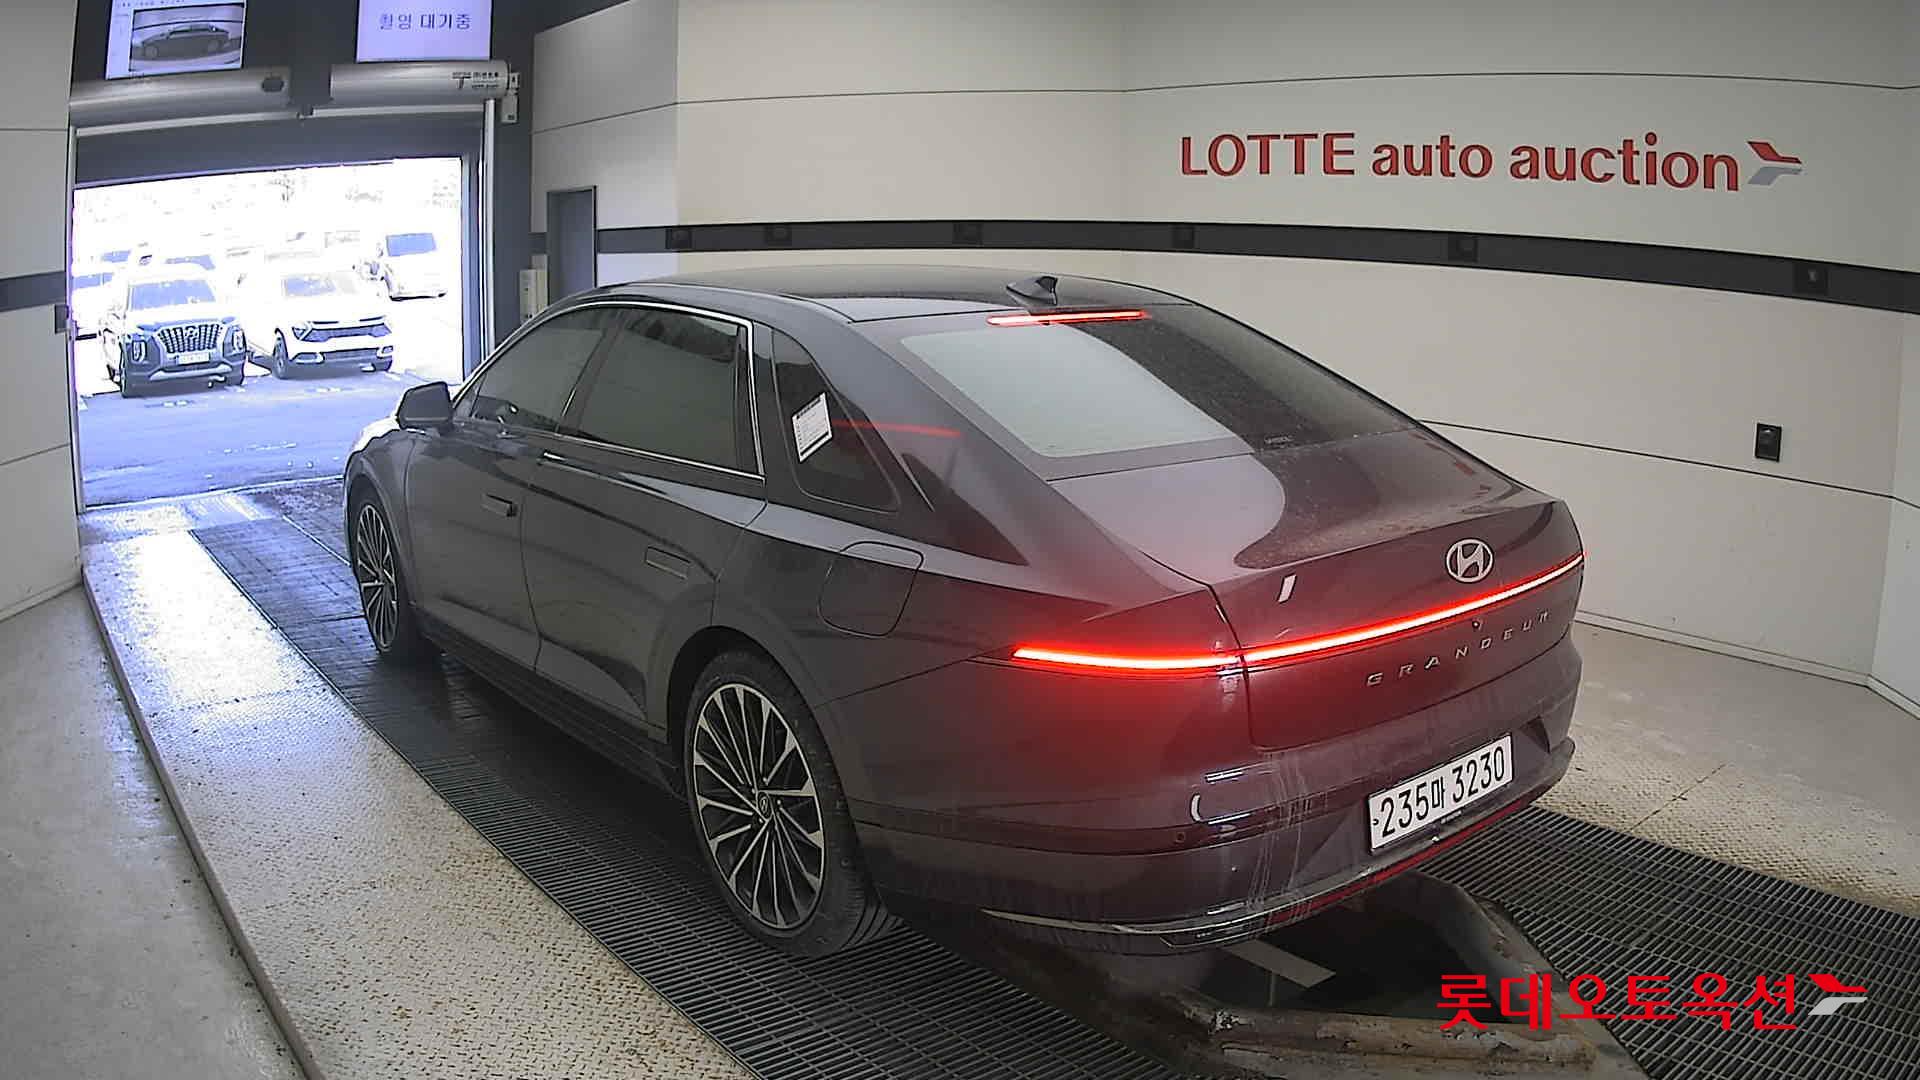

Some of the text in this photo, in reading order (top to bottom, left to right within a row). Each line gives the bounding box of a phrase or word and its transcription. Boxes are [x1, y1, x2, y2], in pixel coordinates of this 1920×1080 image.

[420, 13, 472, 30] 대기중
[1180, 132, 1739, 191] LOTTE auto auction
[1366, 612, 1550, 687] GRANDEUR
[1381, 746, 1505, 838] 235마 3230
